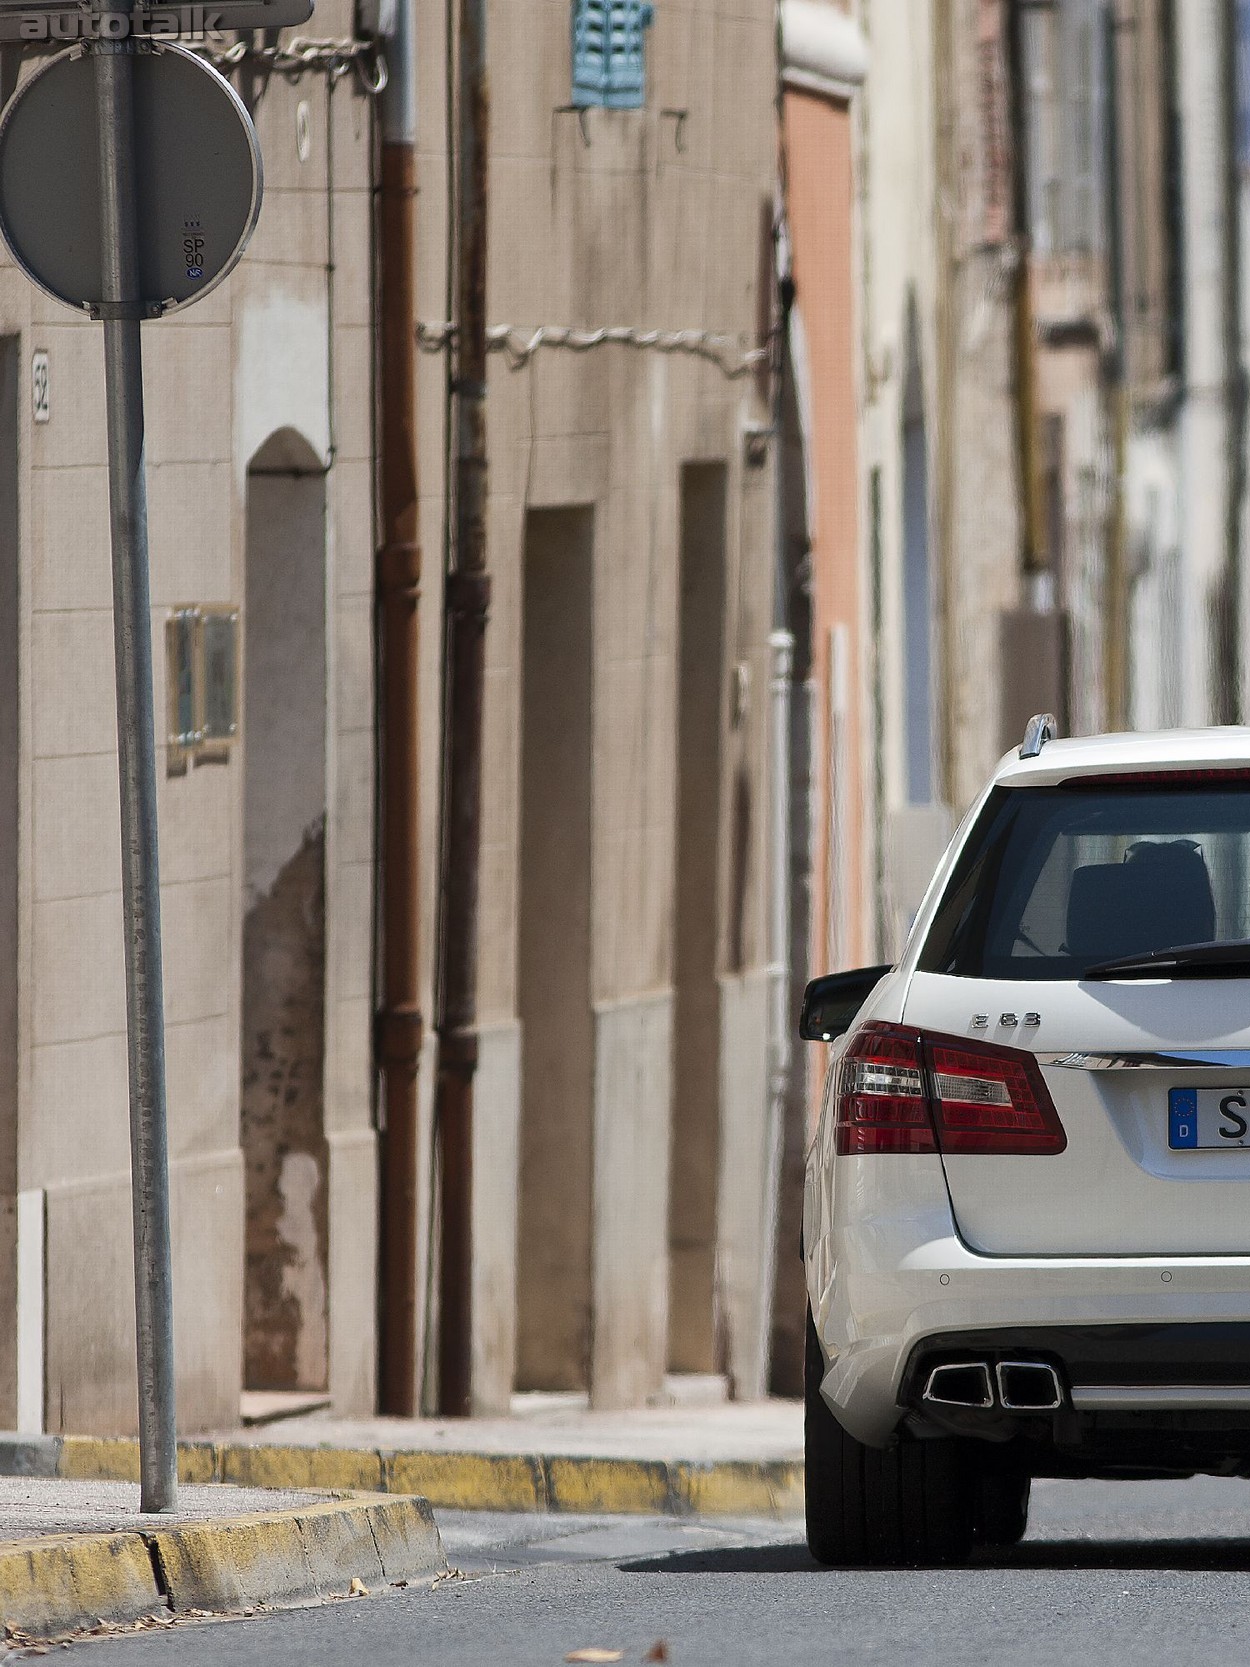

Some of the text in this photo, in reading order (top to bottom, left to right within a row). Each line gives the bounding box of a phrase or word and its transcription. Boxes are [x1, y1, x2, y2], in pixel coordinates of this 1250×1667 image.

[183, 239, 205, 253] SP
[185, 253, 204, 267] 90
[971, 1012, 1041, 1028] E 63
[1218, 1095, 1247, 1139] S
[1179, 1124, 1189, 1138] D
